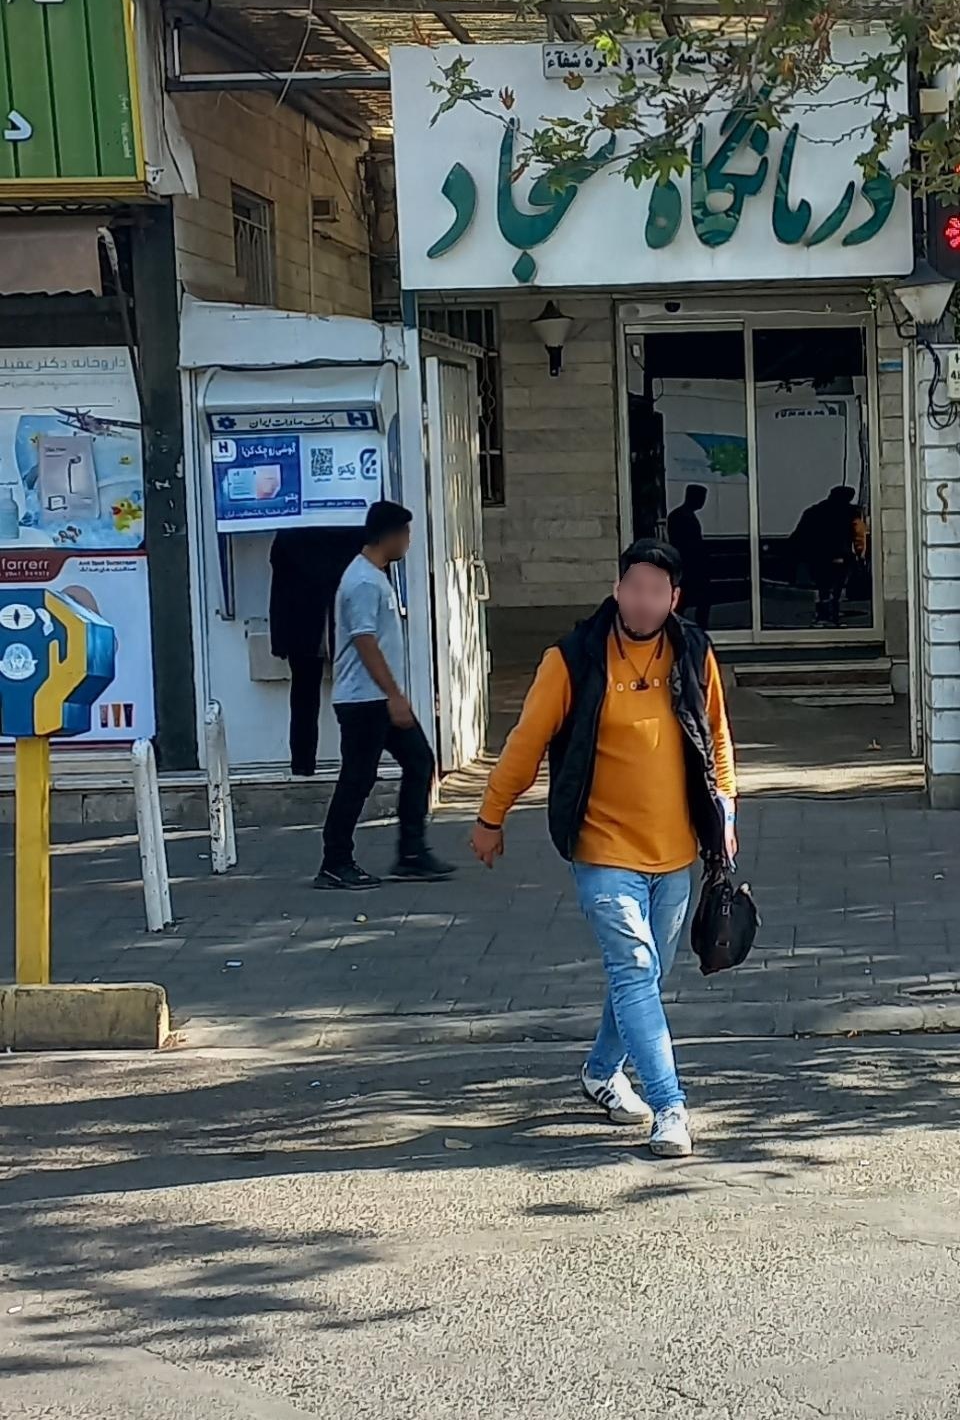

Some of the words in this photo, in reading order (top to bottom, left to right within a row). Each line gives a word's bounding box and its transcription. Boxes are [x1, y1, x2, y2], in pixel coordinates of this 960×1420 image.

[645, 85, 897, 249] درمانگاه
[426, 116, 617, 283] سجاد
[0, 358, 33, 372] عقیل
[34, 356, 67, 371] دکتر
[71, 356, 126, 371] داروخانه
